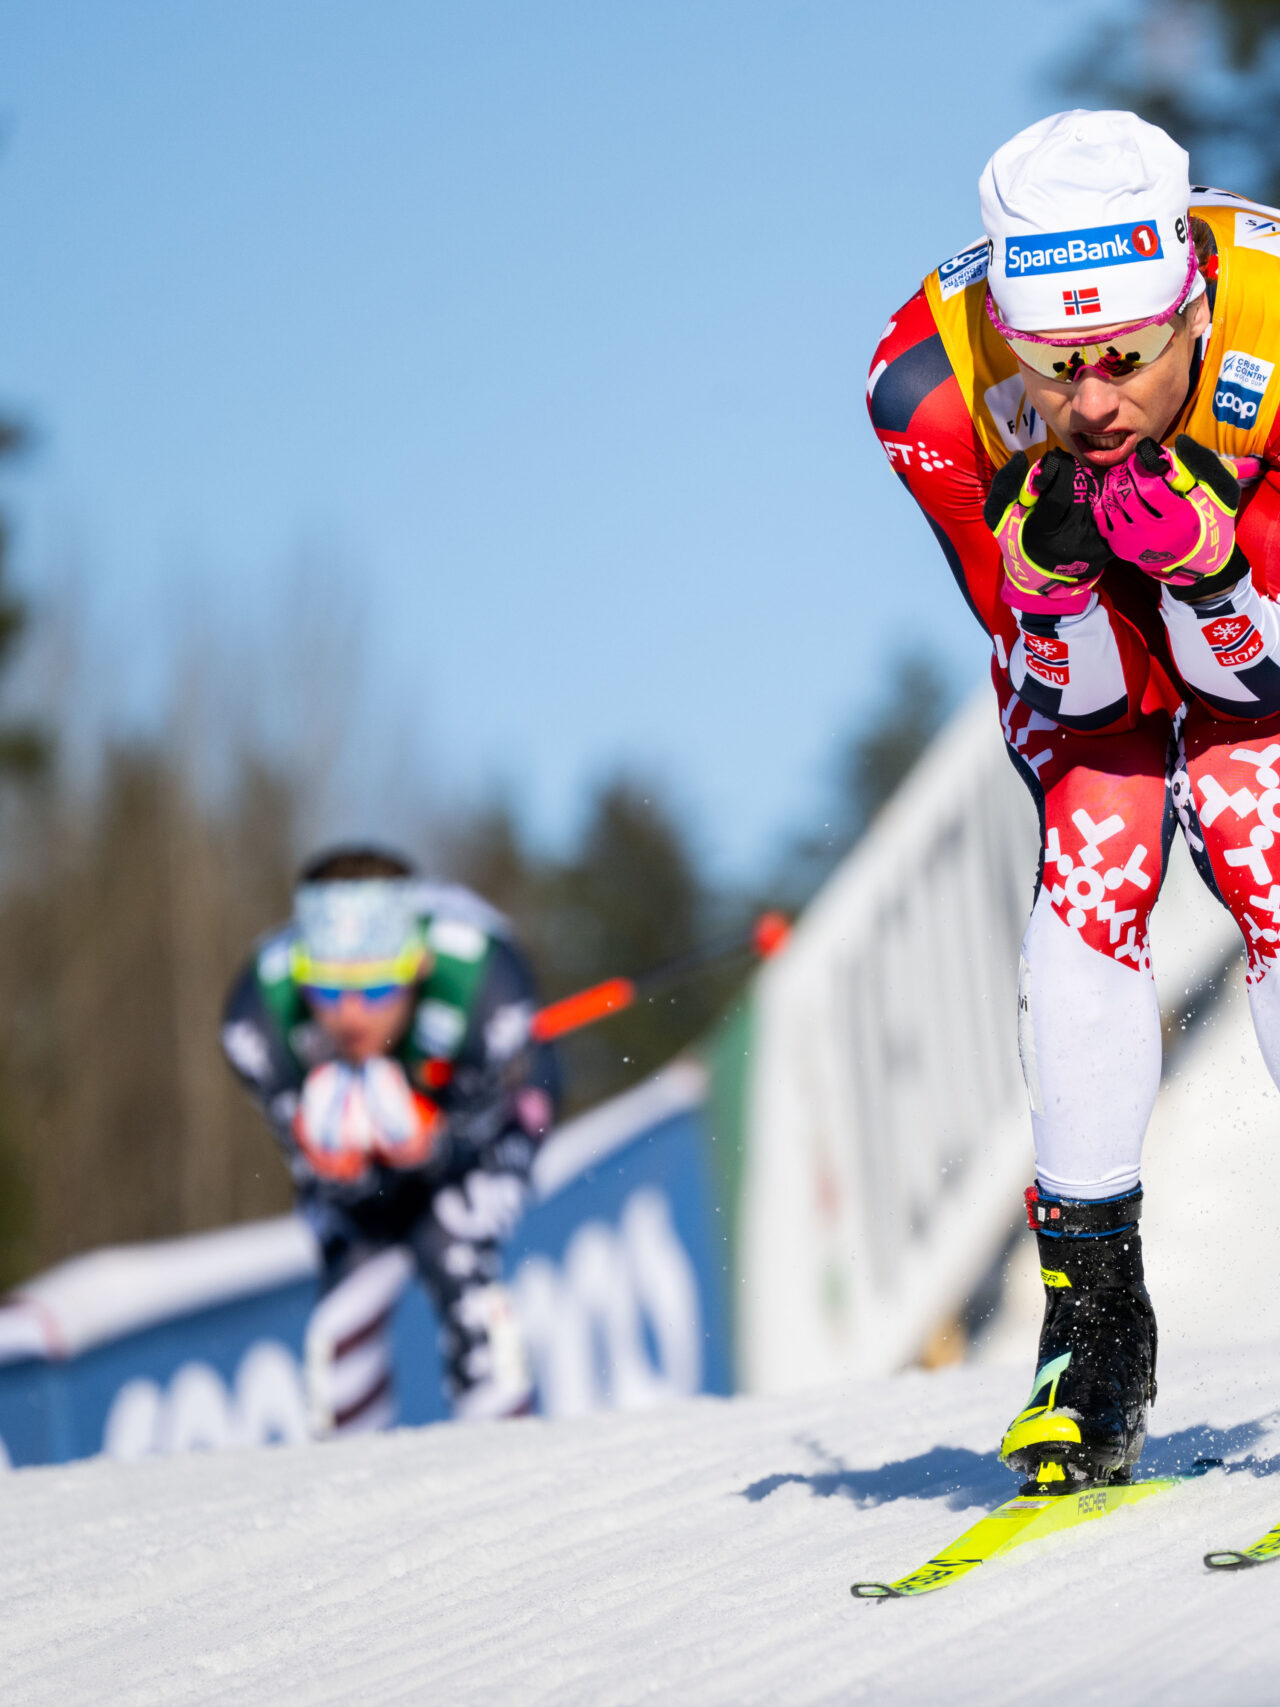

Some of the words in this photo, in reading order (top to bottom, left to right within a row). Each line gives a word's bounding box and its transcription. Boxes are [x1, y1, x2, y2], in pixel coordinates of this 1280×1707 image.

[1008, 233, 1132, 274] SpareBank
[1138, 229, 1152, 251] 1
[1215, 390, 1257, 419] coop
